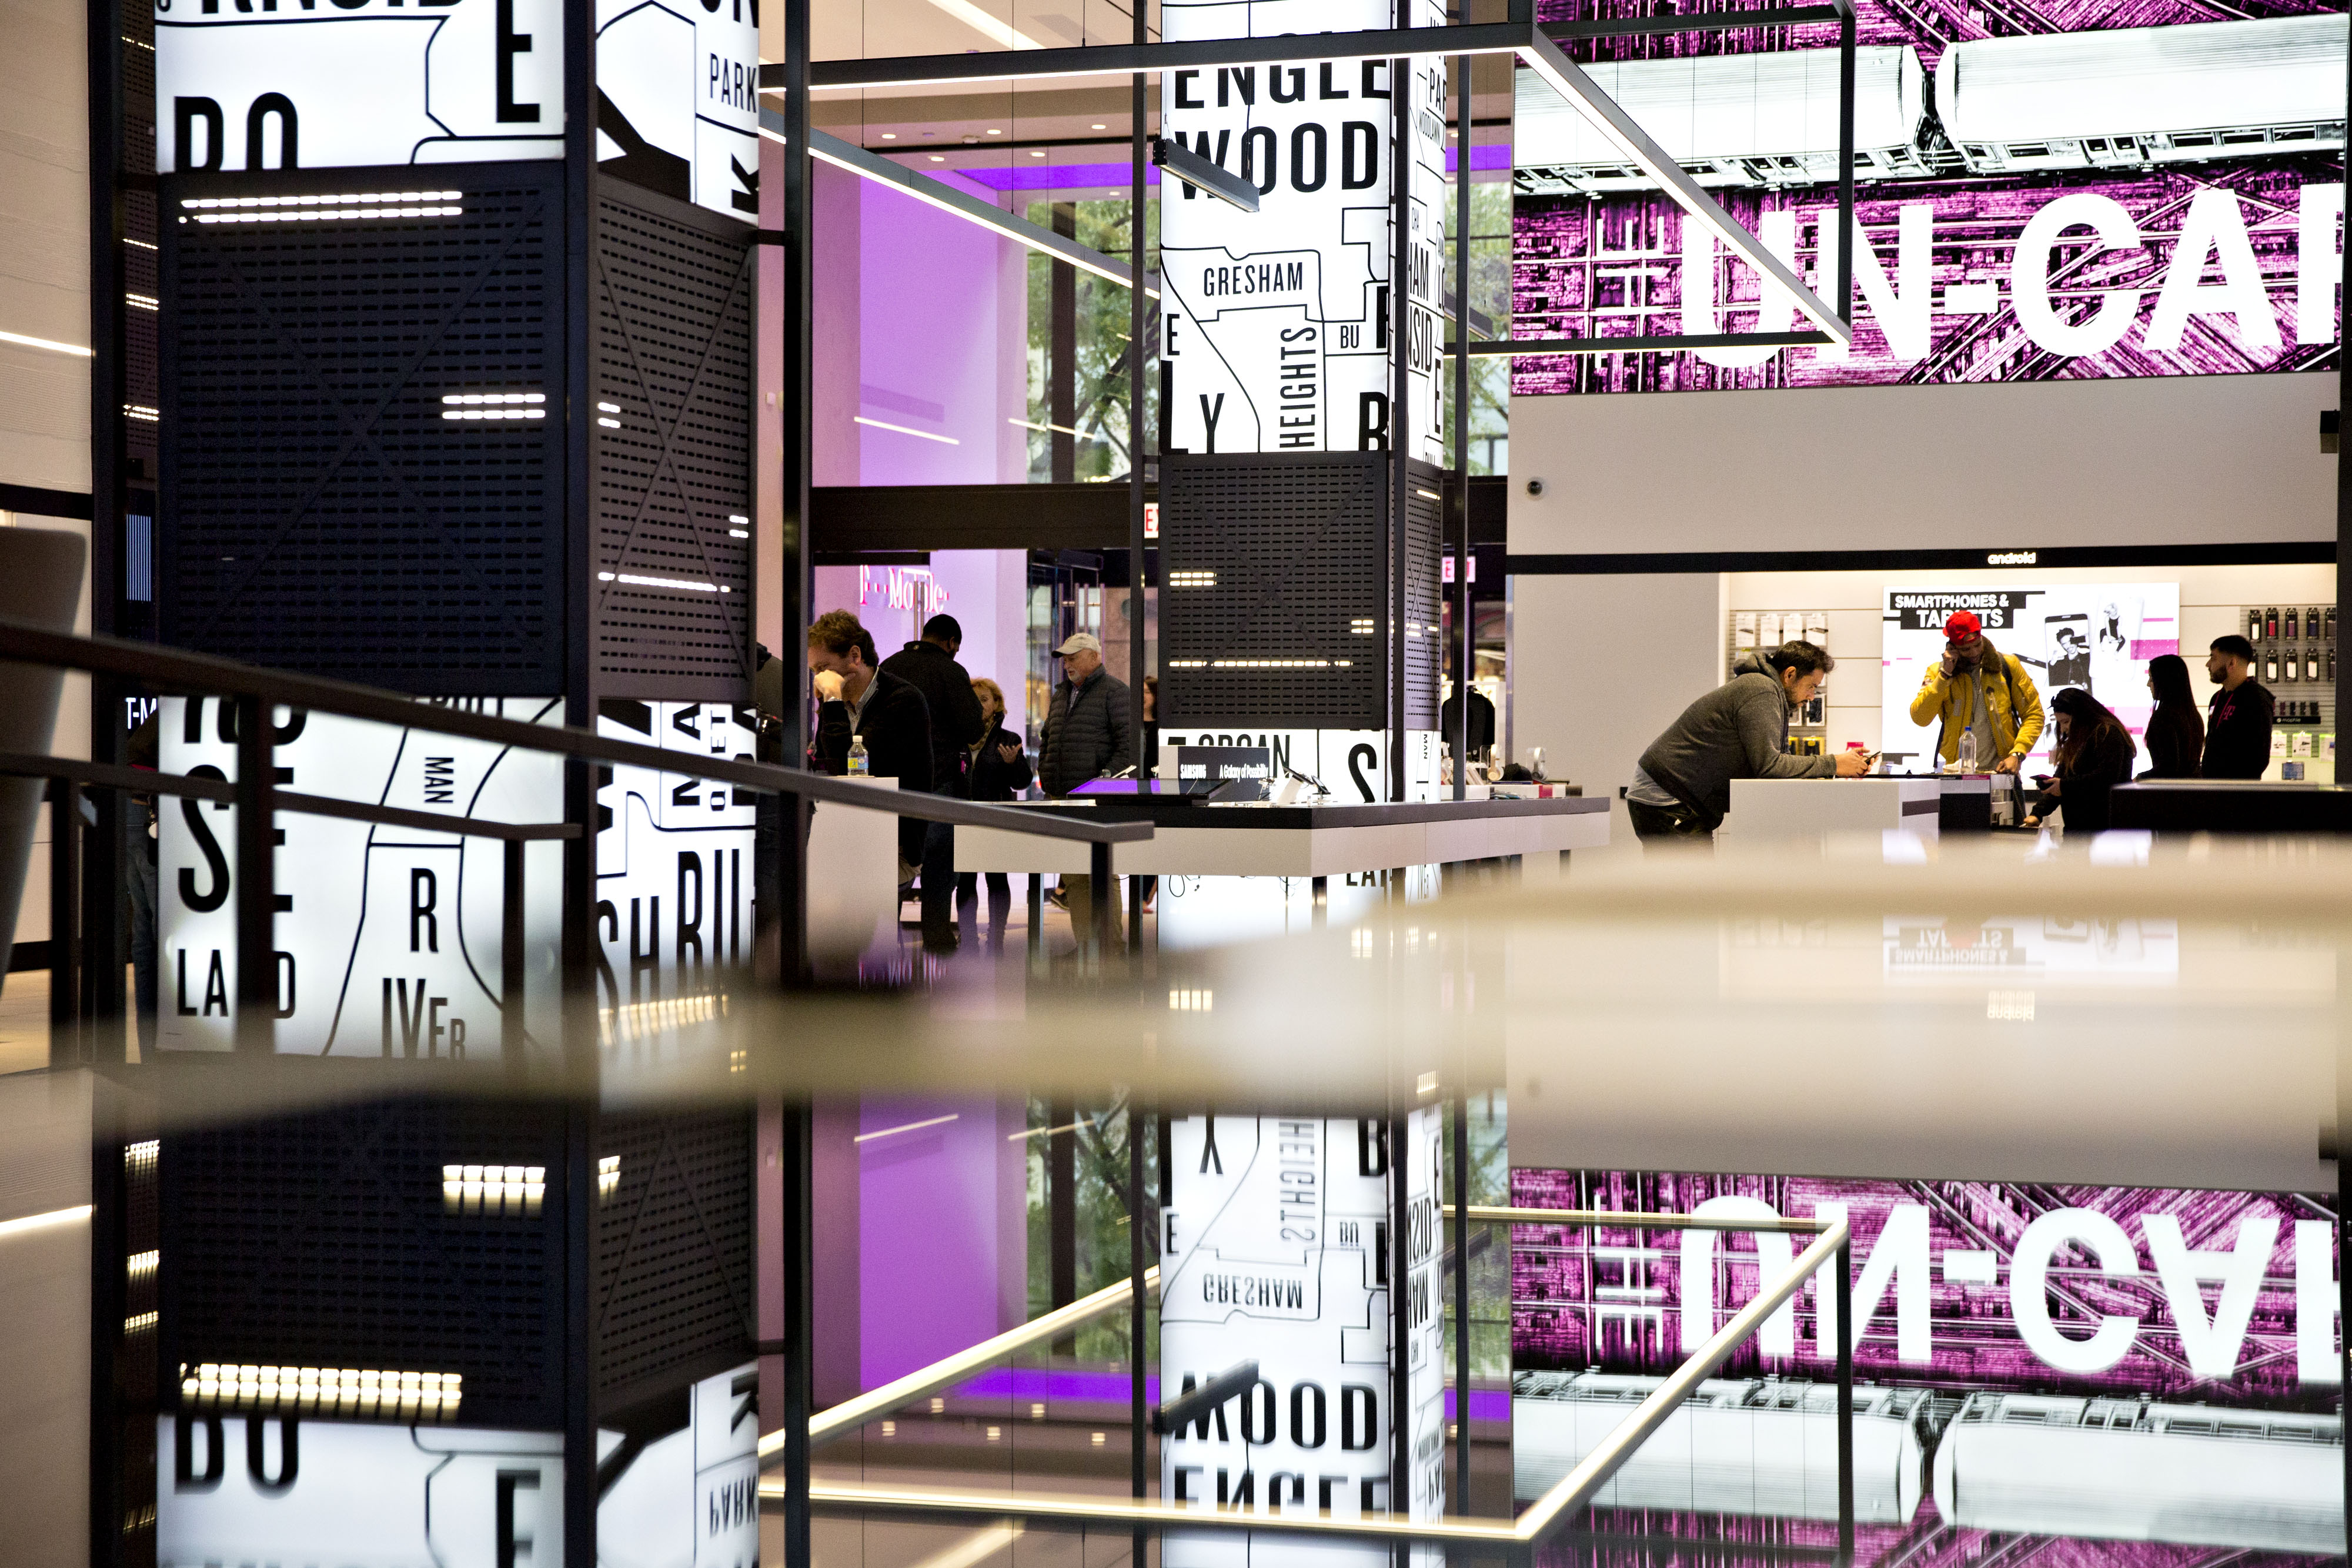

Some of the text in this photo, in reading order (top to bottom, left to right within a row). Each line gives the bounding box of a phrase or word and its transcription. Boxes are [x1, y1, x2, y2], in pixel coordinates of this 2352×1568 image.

[710, 52, 757, 113] PARK
[1175, 121, 1378, 200] WOOD
[1204, 262, 1303, 297] GRESHAM
[1341, 325, 1359, 349] BU
[1280, 327, 1317, 449] HEIGHTS
[1987, 551, 2036, 564] android
[1895, 594, 2009, 609] SMARTPHONES &
[1916, 609, 2004, 628] TATS
[425, 757, 455, 804] MAN
[1180, 764, 1207, 779] SAMSUNG
[1224, 764, 1241, 783] Galaxy
[1247, 763, 1269, 779] Possibility
[411, 868, 439, 953] R
[178, 949, 295, 1019] LAD
